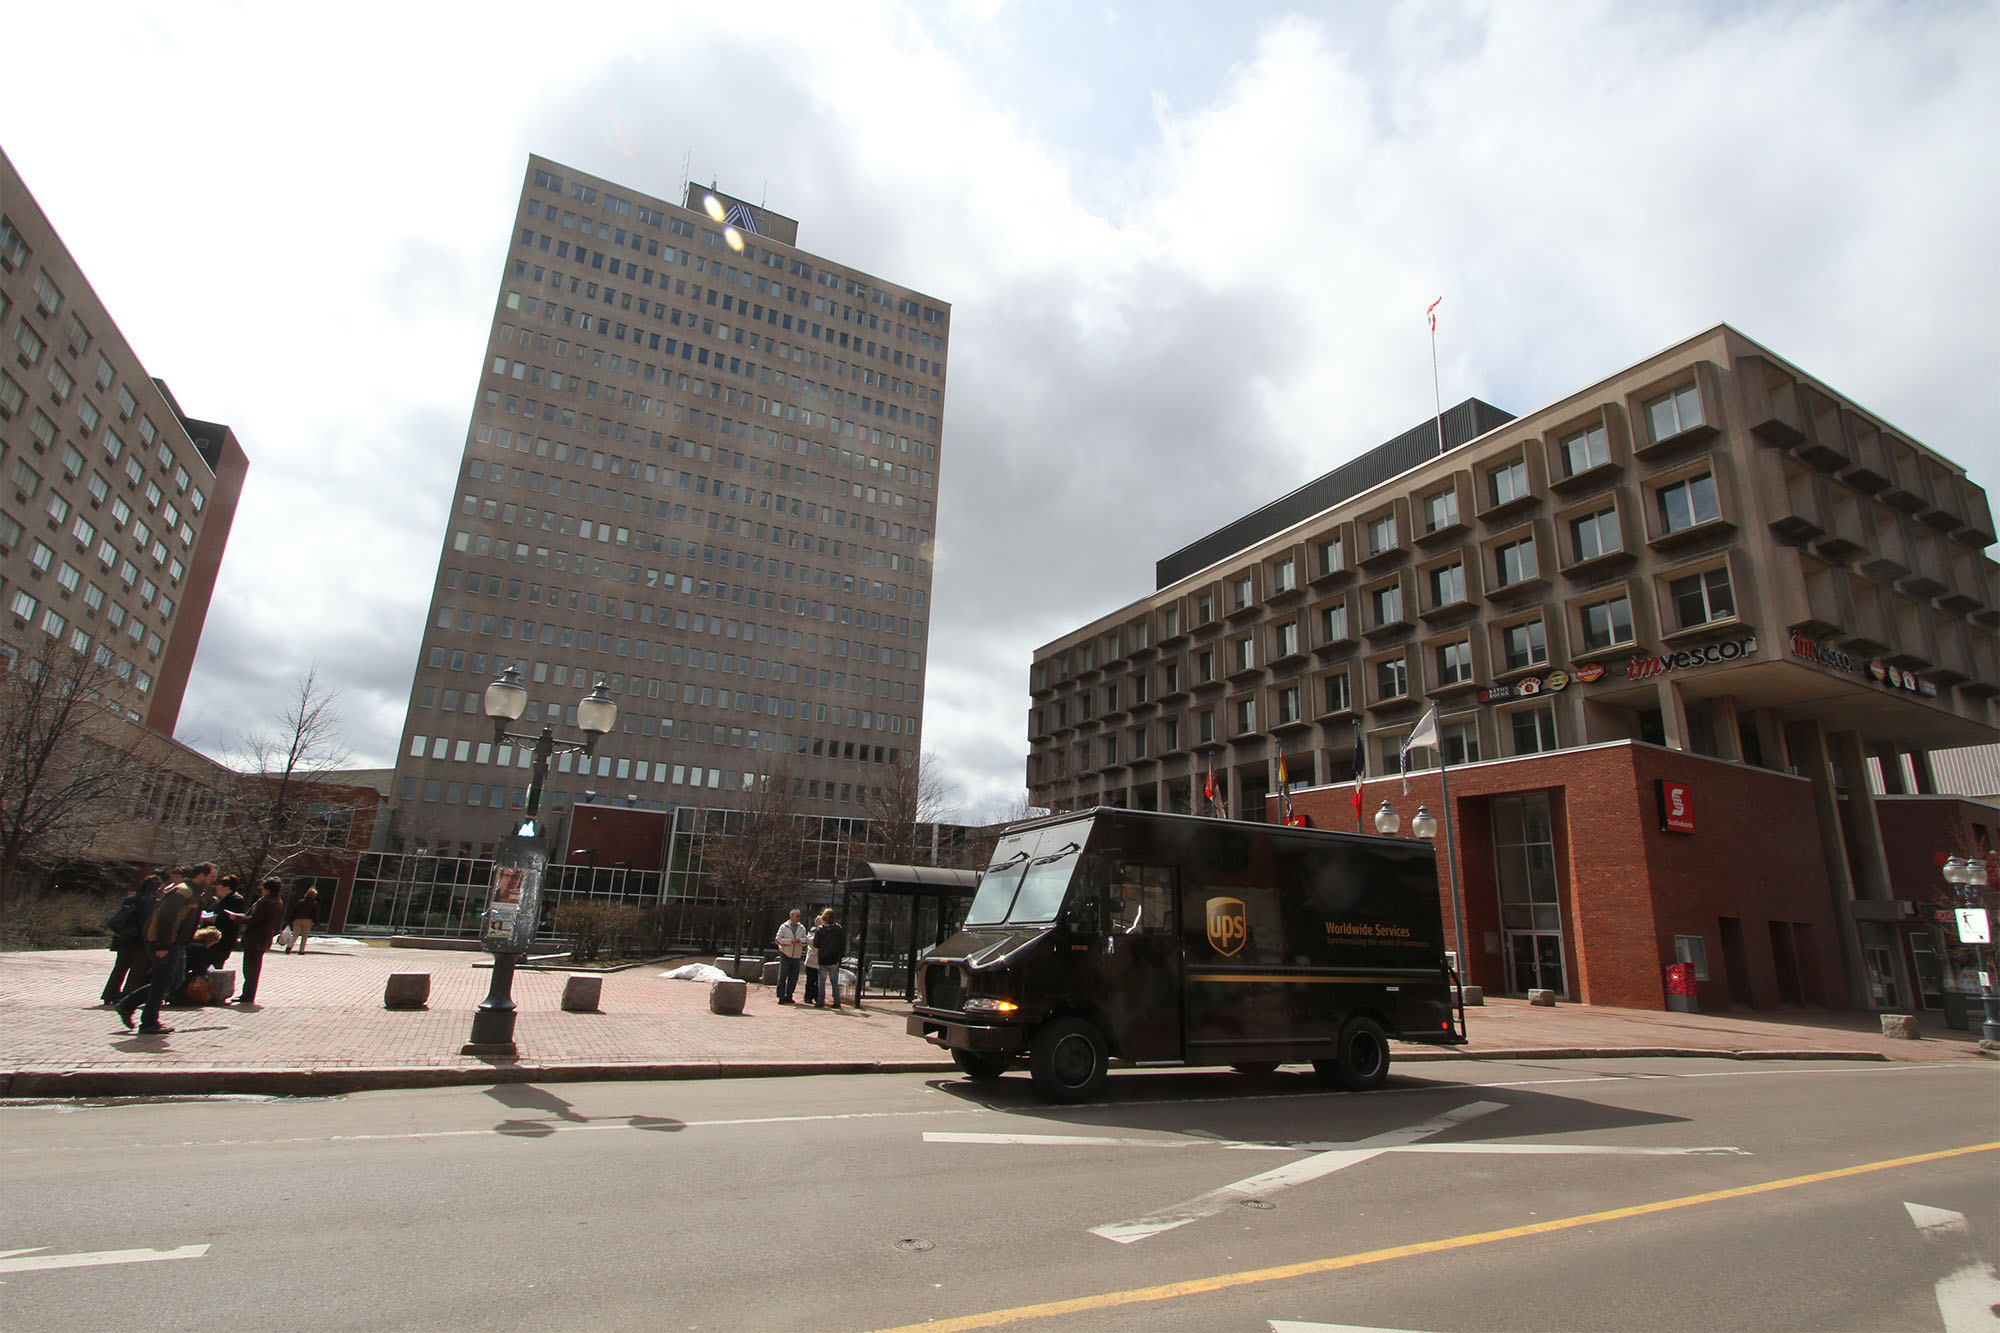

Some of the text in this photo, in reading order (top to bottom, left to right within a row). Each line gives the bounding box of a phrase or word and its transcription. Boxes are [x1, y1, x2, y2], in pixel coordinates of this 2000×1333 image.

[1626, 636, 1757, 680] imvescor
[1210, 915, 1244, 947] ups
[1325, 921, 1411, 937] Worldwide Services
